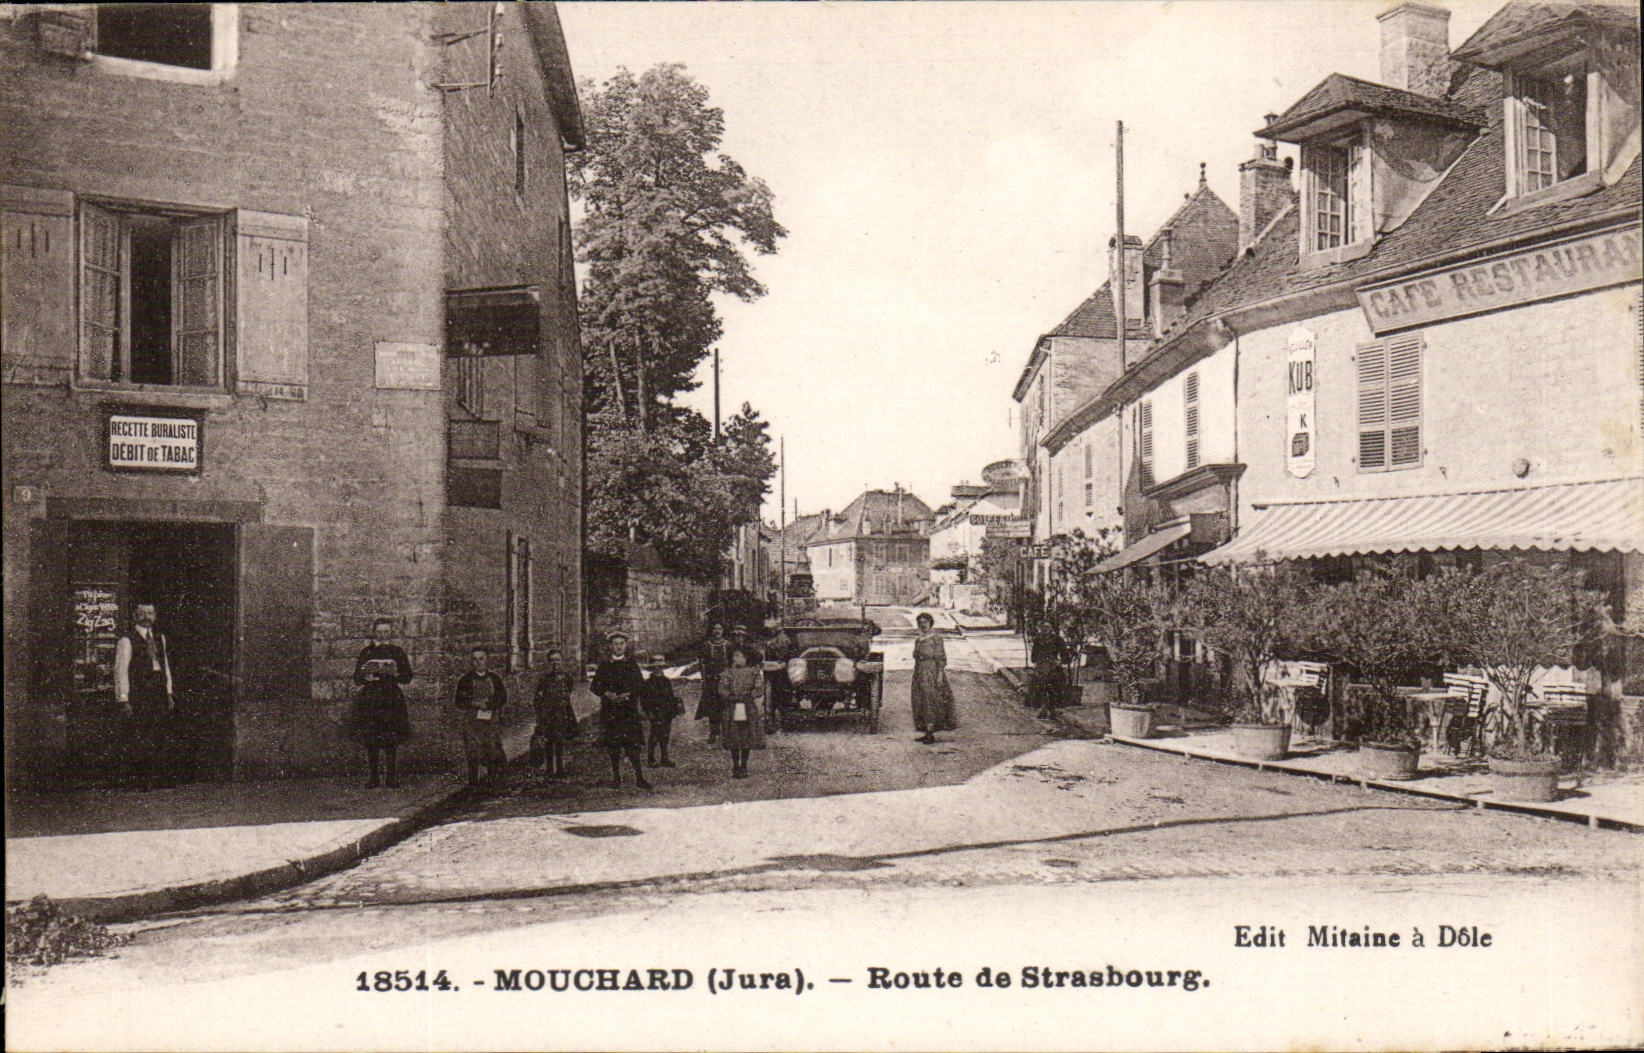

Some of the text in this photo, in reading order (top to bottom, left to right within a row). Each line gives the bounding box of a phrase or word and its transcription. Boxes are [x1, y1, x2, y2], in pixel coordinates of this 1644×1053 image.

[1288, 360, 1313, 394] KUB
[111, 421, 196, 439] RECETTE BURALISTE
[1300, 414, 1307, 428] K
[161, 445, 195, 463] TABAC
